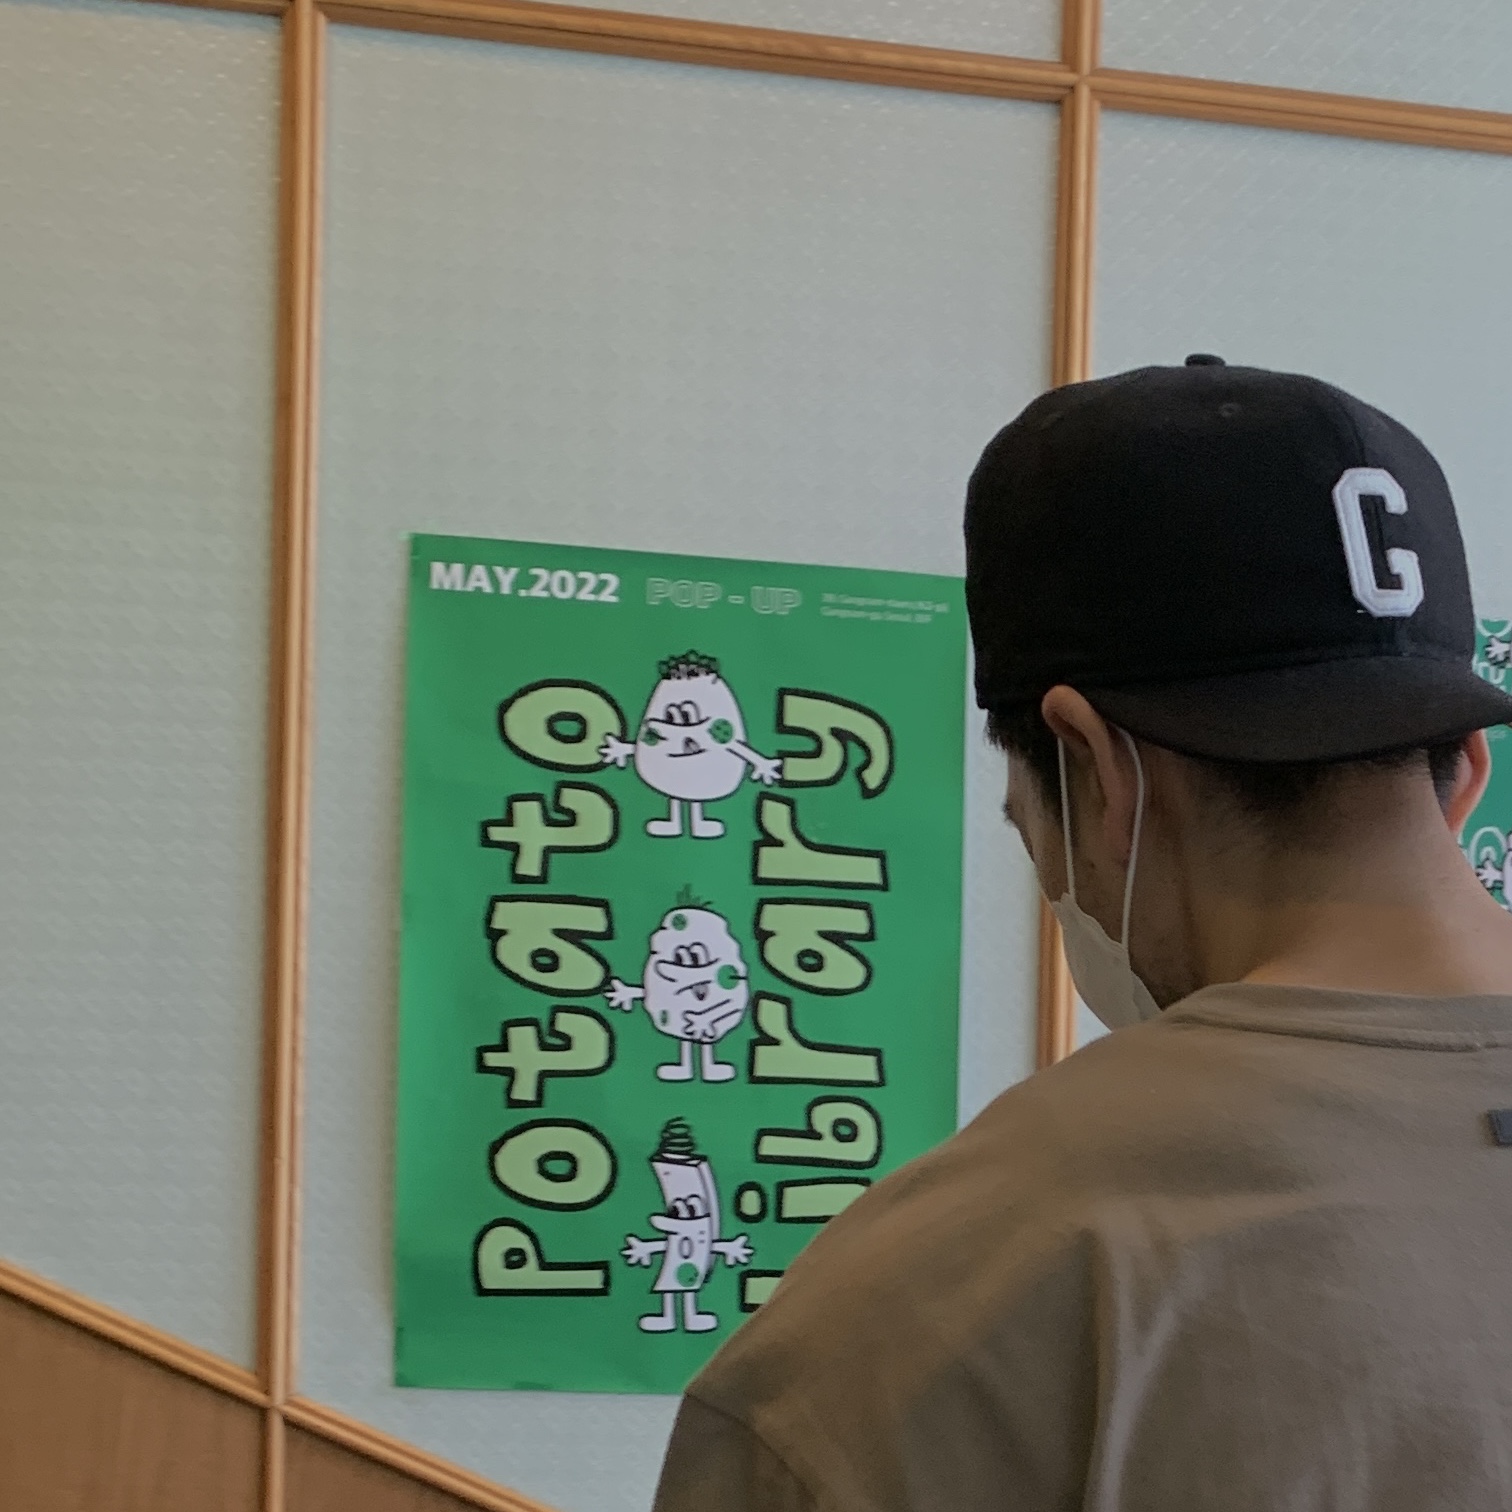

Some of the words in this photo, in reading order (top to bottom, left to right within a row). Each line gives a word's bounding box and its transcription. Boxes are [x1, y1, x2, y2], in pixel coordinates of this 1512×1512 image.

[430, 561, 620, 602] MAY.2022
[1331, 467, 1424, 617] G
[473, 678, 627, 1297] Potato
